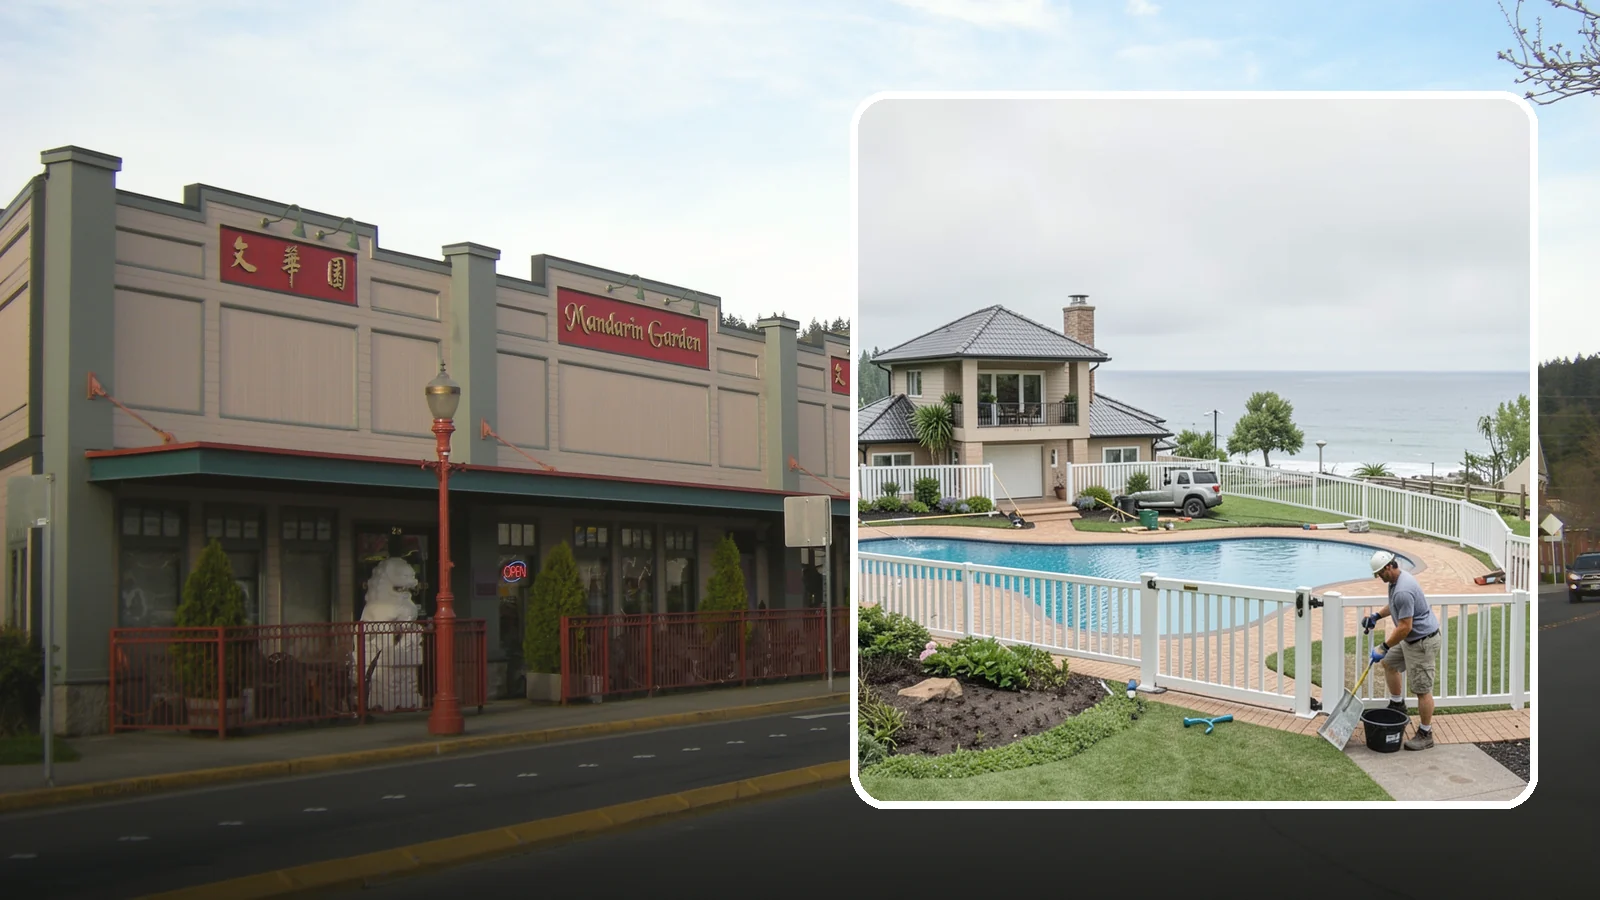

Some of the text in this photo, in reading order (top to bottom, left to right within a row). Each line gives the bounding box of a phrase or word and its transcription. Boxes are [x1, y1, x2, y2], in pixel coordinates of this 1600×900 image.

[231, 235, 346, 291] 文華園
[564, 302, 701, 352] Mandarin Garden
[503, 565, 527, 578] OPEN
